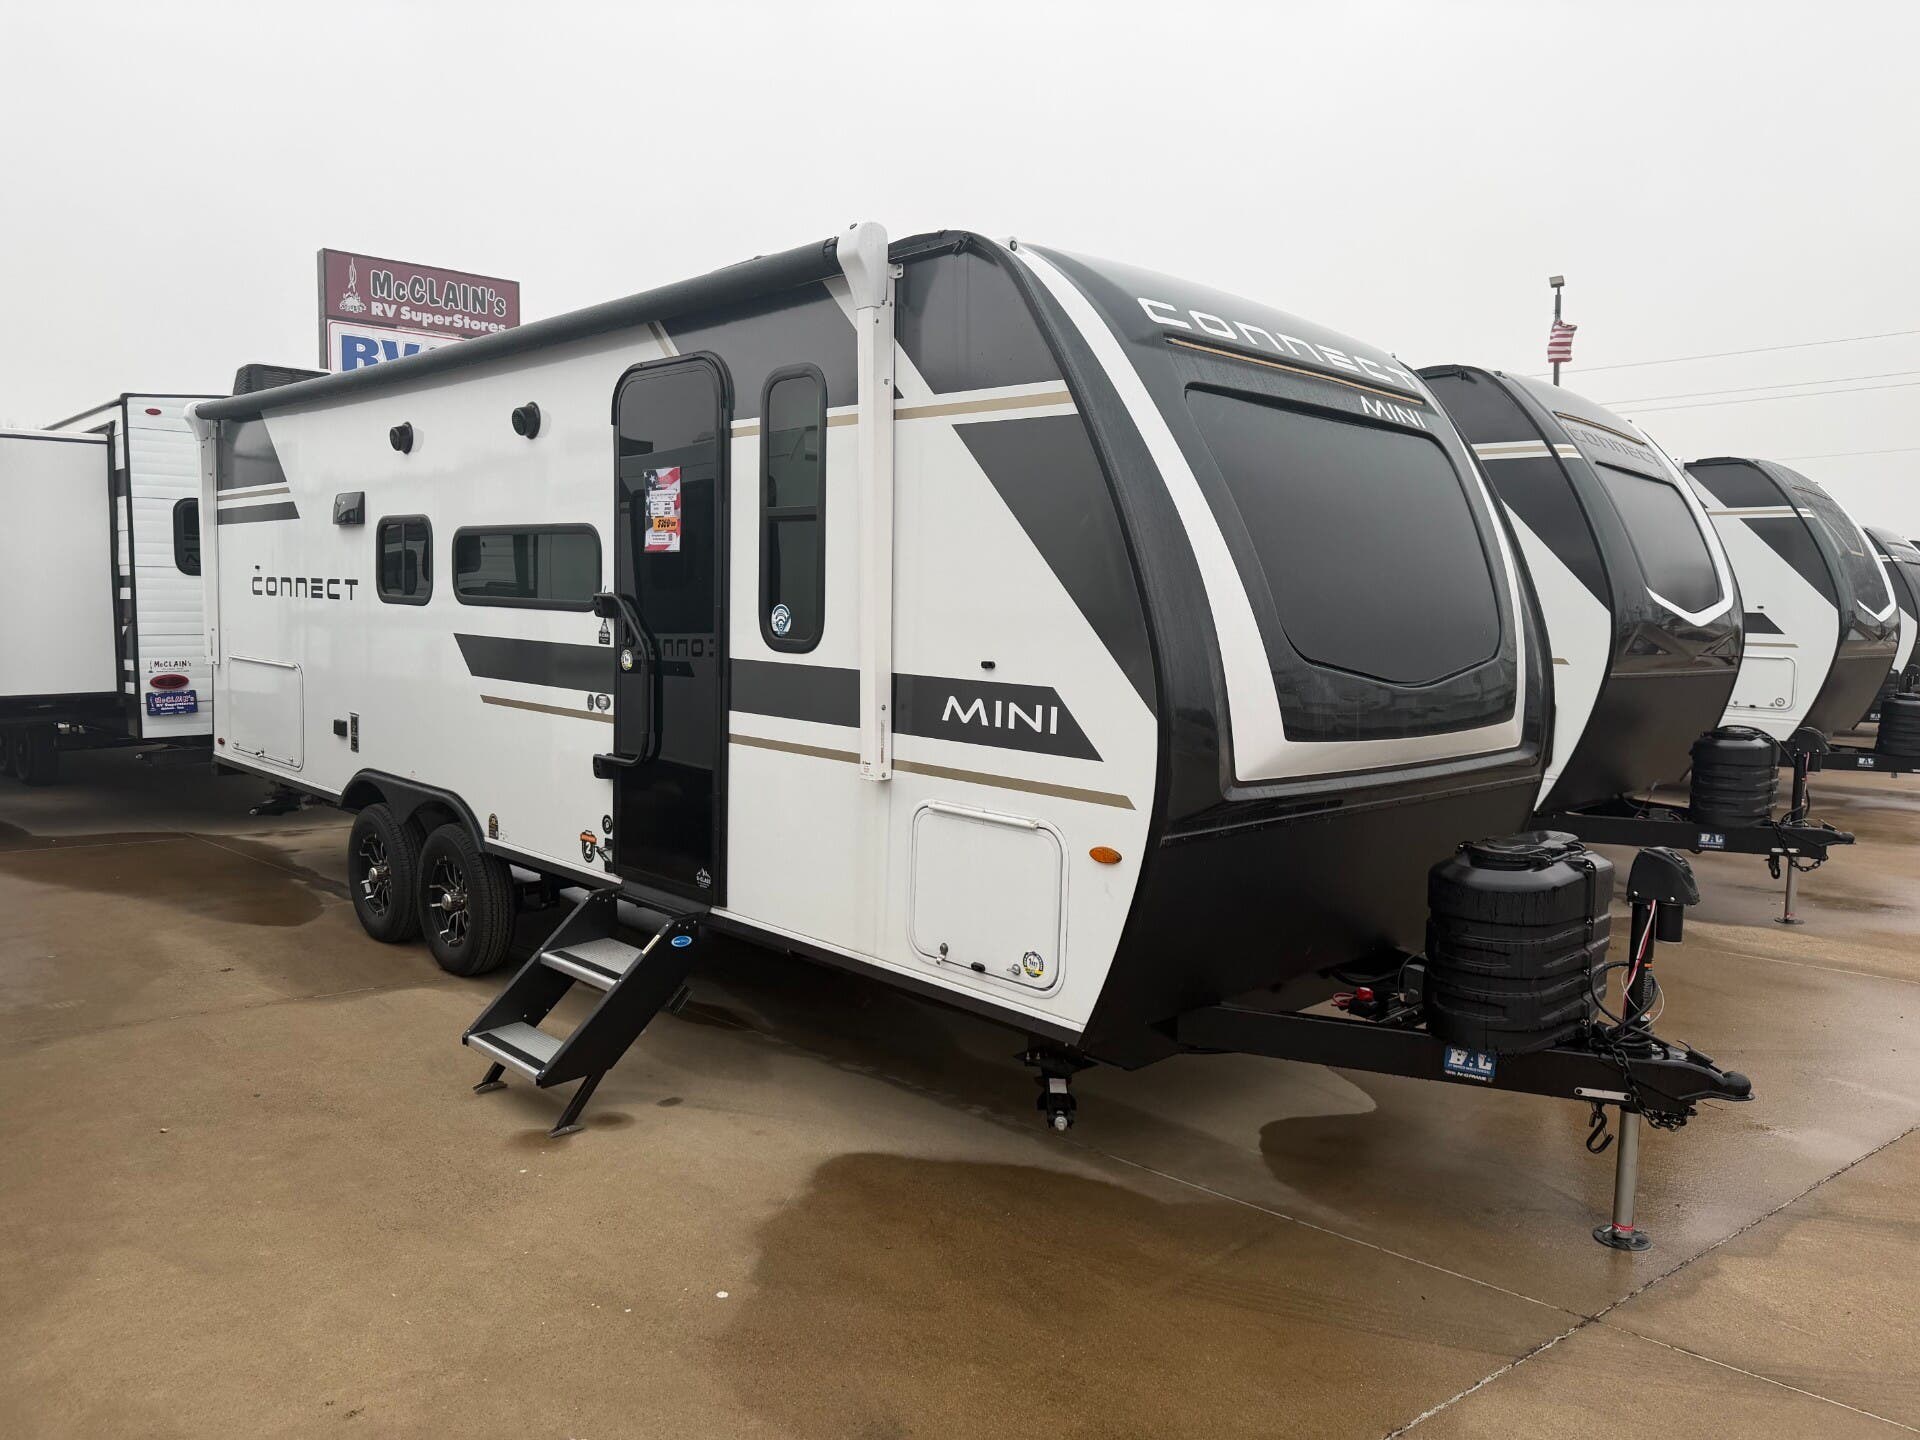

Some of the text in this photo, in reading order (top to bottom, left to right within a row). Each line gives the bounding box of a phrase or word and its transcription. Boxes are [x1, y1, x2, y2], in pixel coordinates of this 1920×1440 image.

[370, 269, 507, 318] McCLAIN's
[371, 301, 506, 333] RV SuperStores
[1360, 395, 1427, 429] MINI
[941, 695, 1058, 735] MINI
